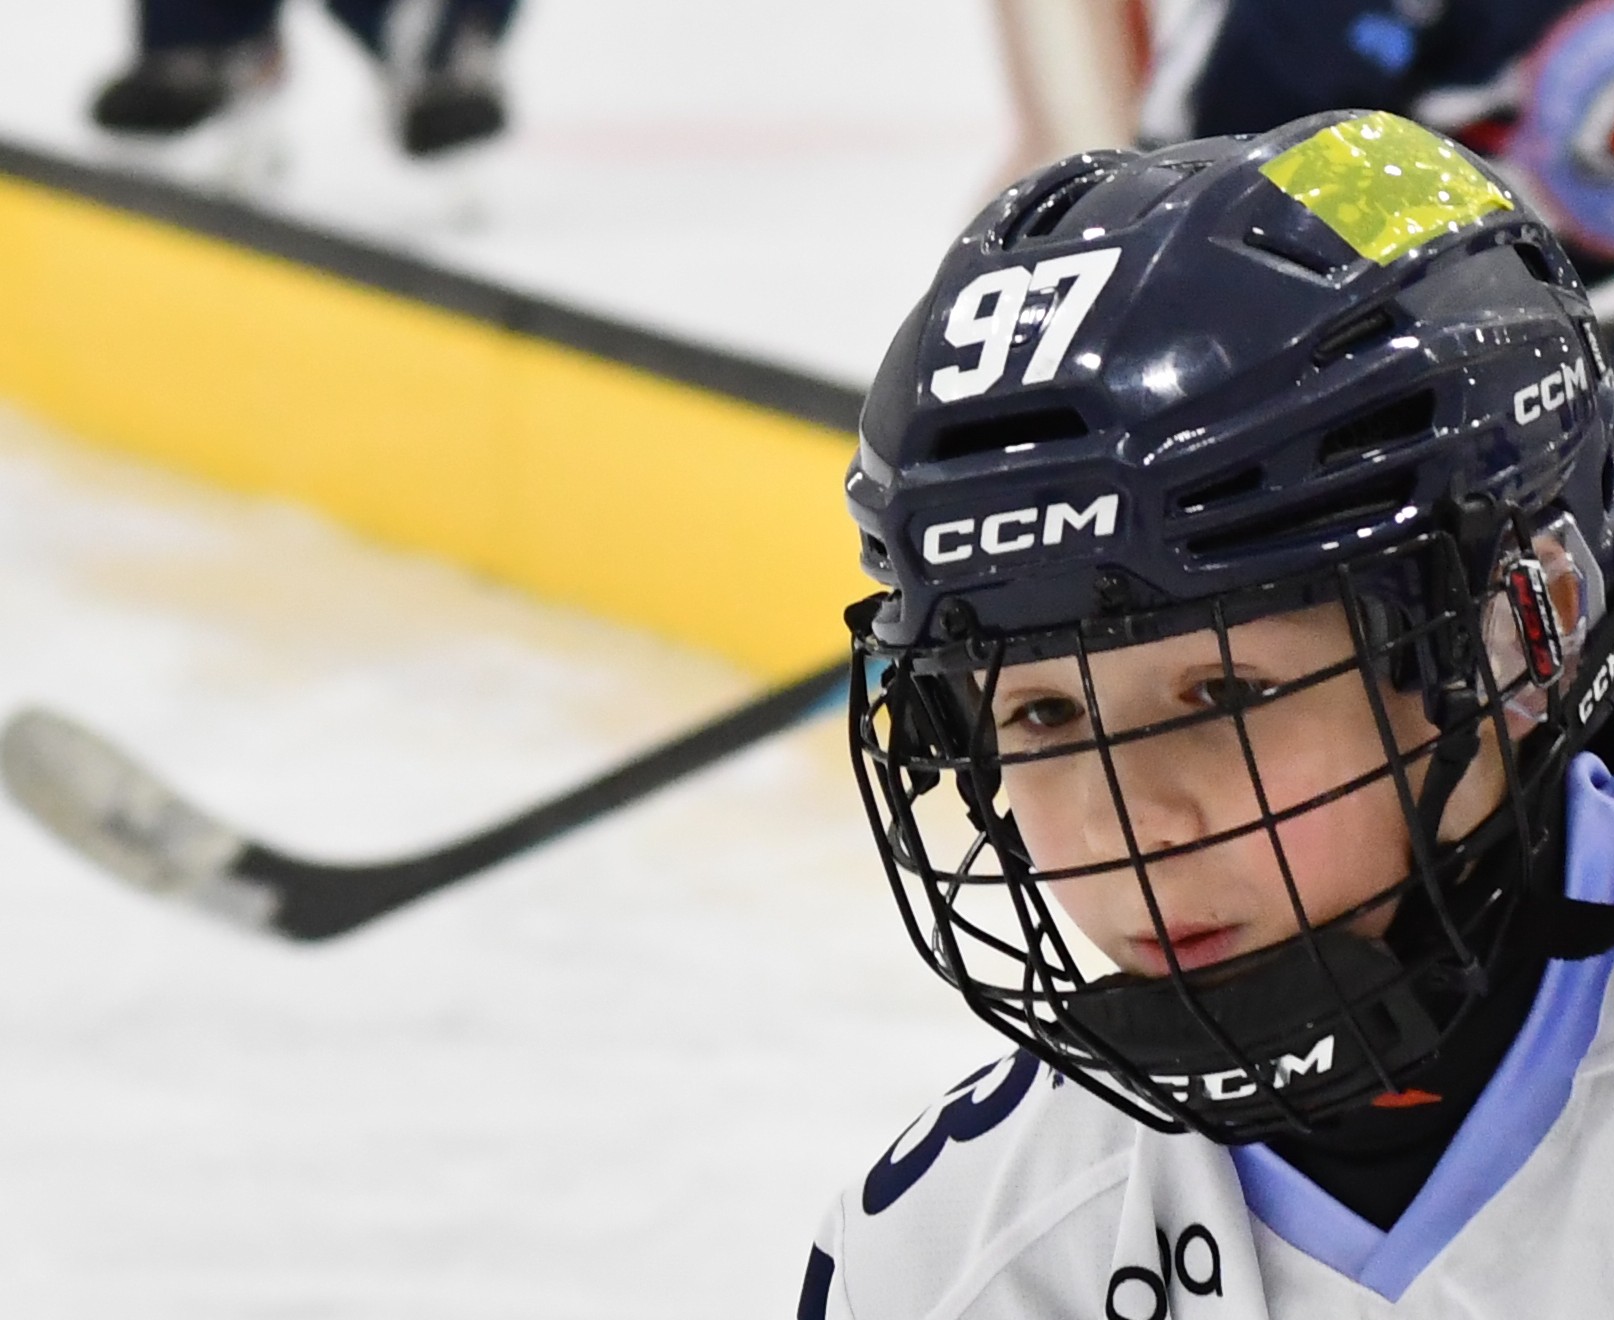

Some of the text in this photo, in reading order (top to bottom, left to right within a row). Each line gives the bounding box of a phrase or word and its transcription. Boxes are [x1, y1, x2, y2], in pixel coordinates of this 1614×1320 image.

[930, 246, 1122, 403] 97
[1513, 355, 1588, 426] CCM
[921, 493, 1119, 566] CCM
